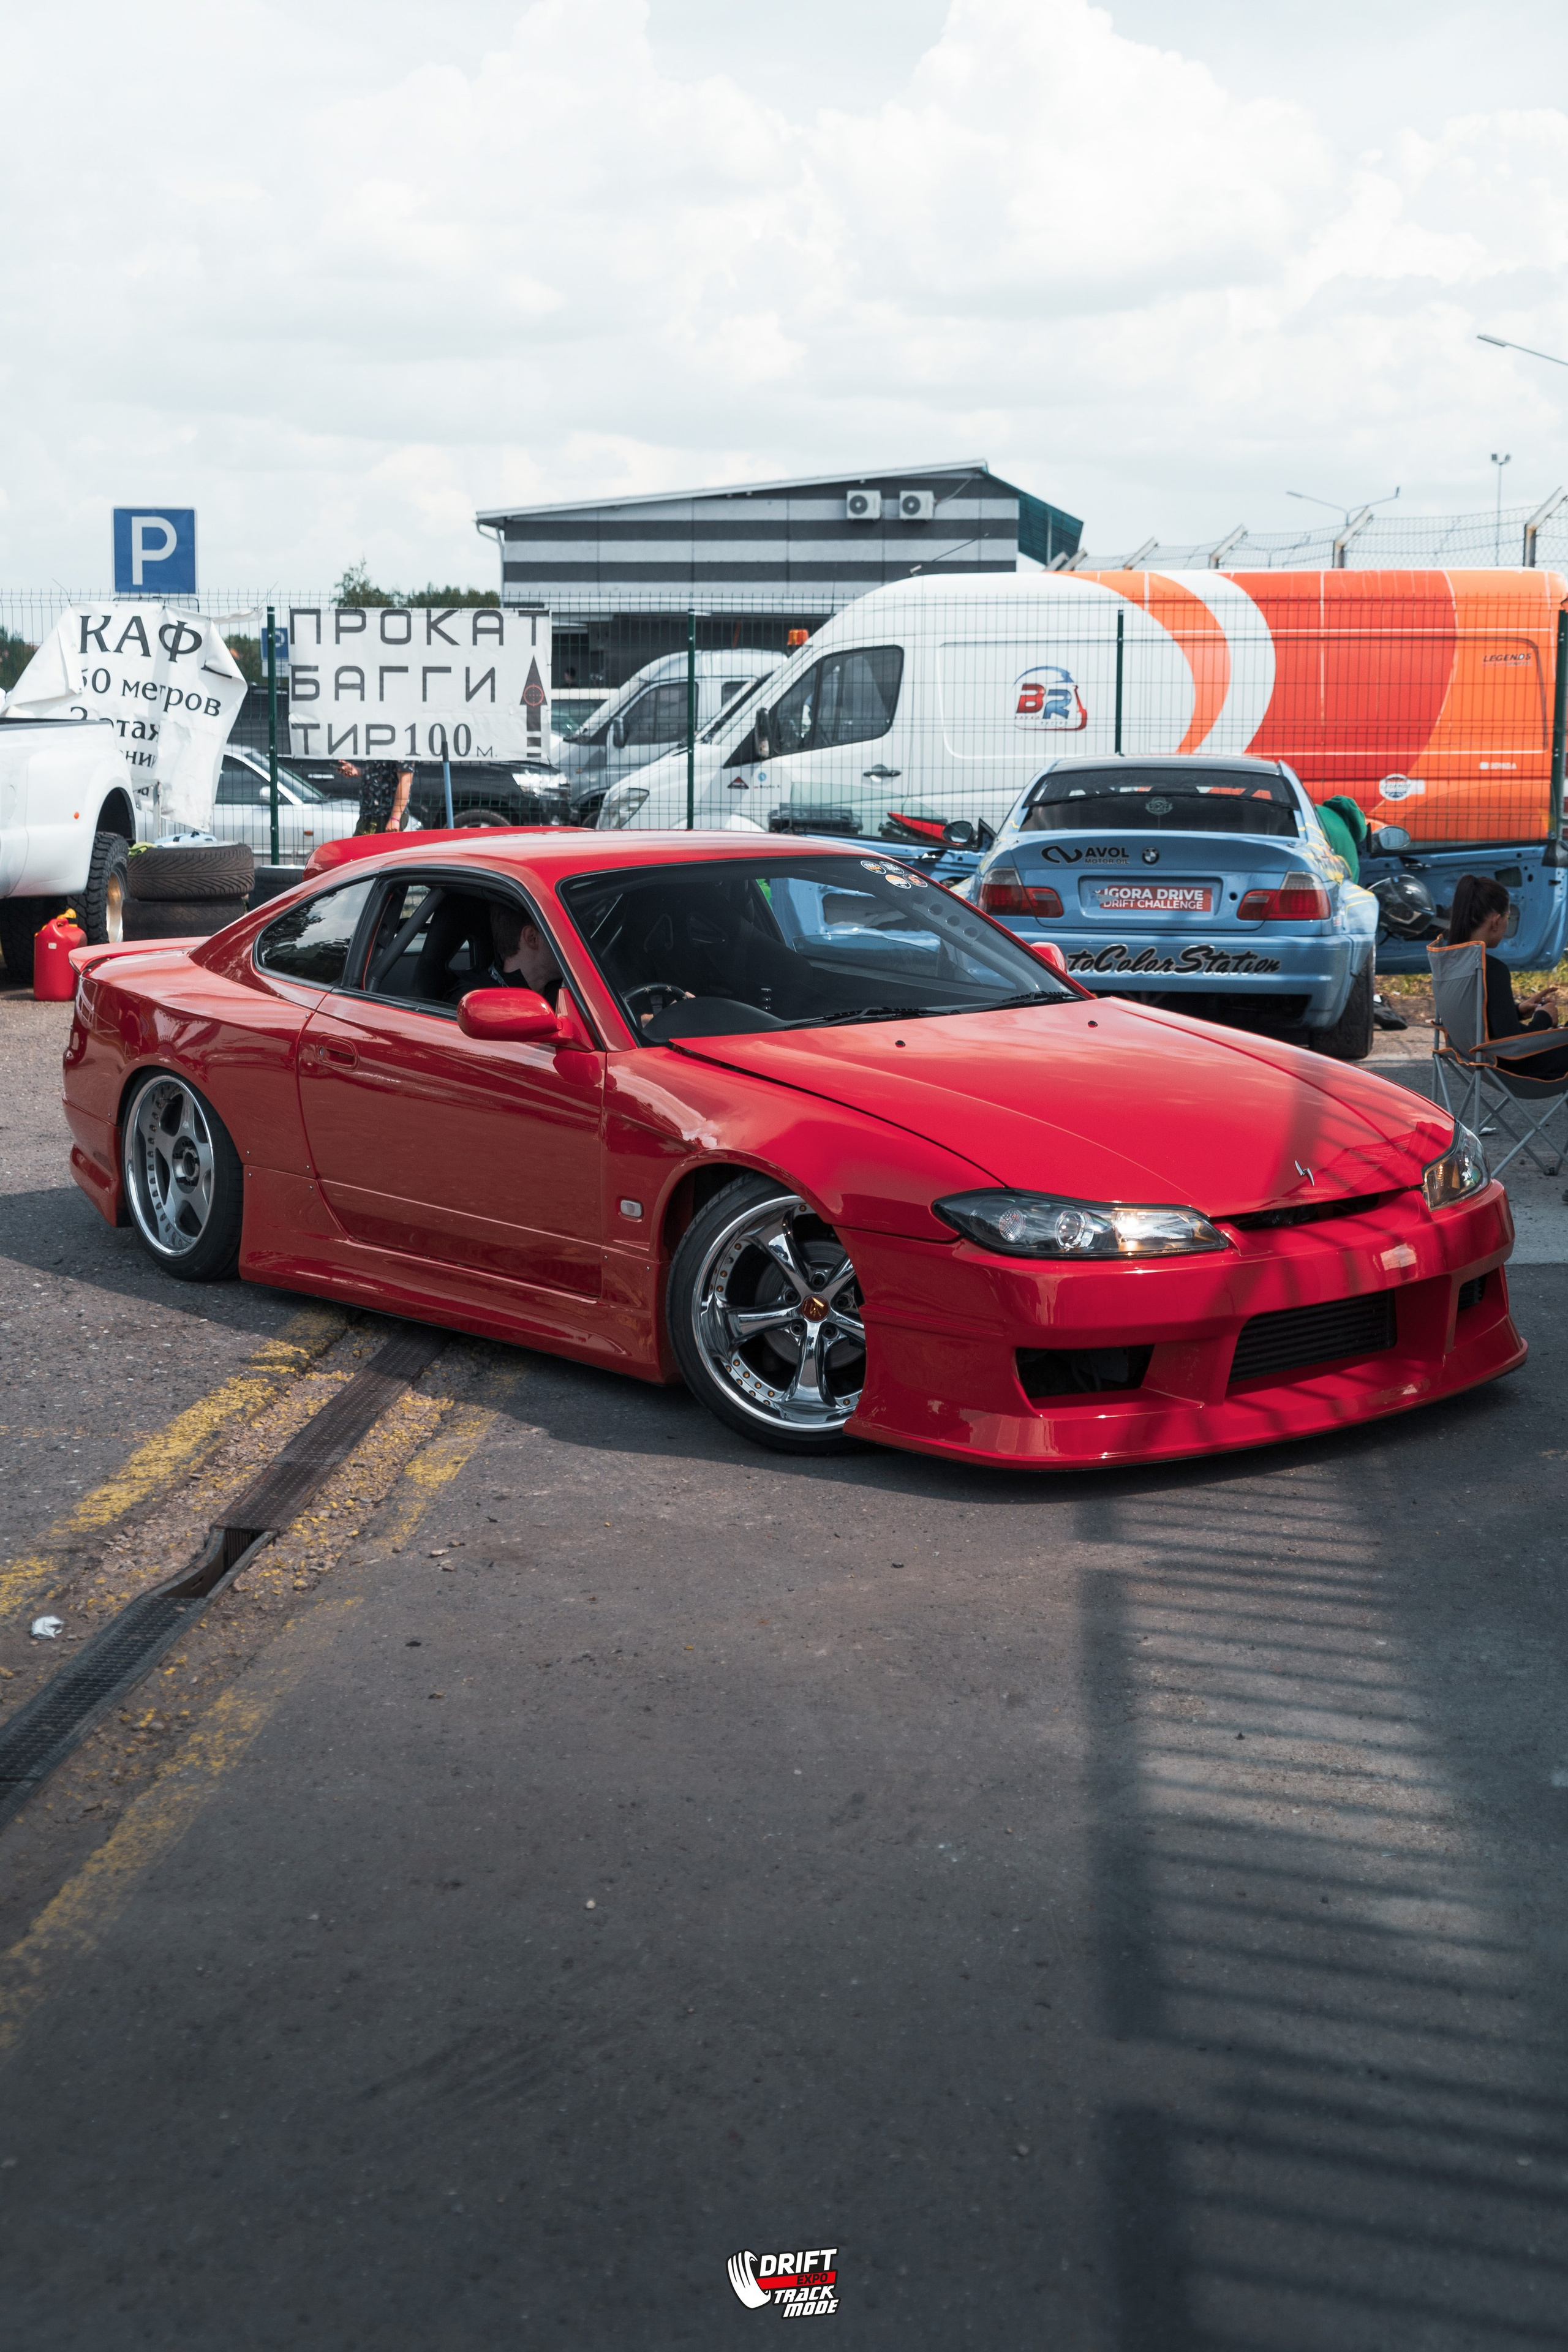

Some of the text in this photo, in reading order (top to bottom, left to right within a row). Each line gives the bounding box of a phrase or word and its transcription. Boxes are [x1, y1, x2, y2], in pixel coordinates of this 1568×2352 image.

[131, 516, 178, 586] P
[289, 609, 549, 646] ПРОКАТ
[78, 615, 232, 678] КАФ
[1483, 653, 1531, 662] LEGENDS
[291, 665, 496, 703] БАГГИ
[1085, 847, 1129, 858] AVOL
[1103, 899, 1204, 910] DRIFT CHALLENGE
[1157, 889, 1204, 901] DRIVE
[1066, 944, 1281, 974] toColorStation
